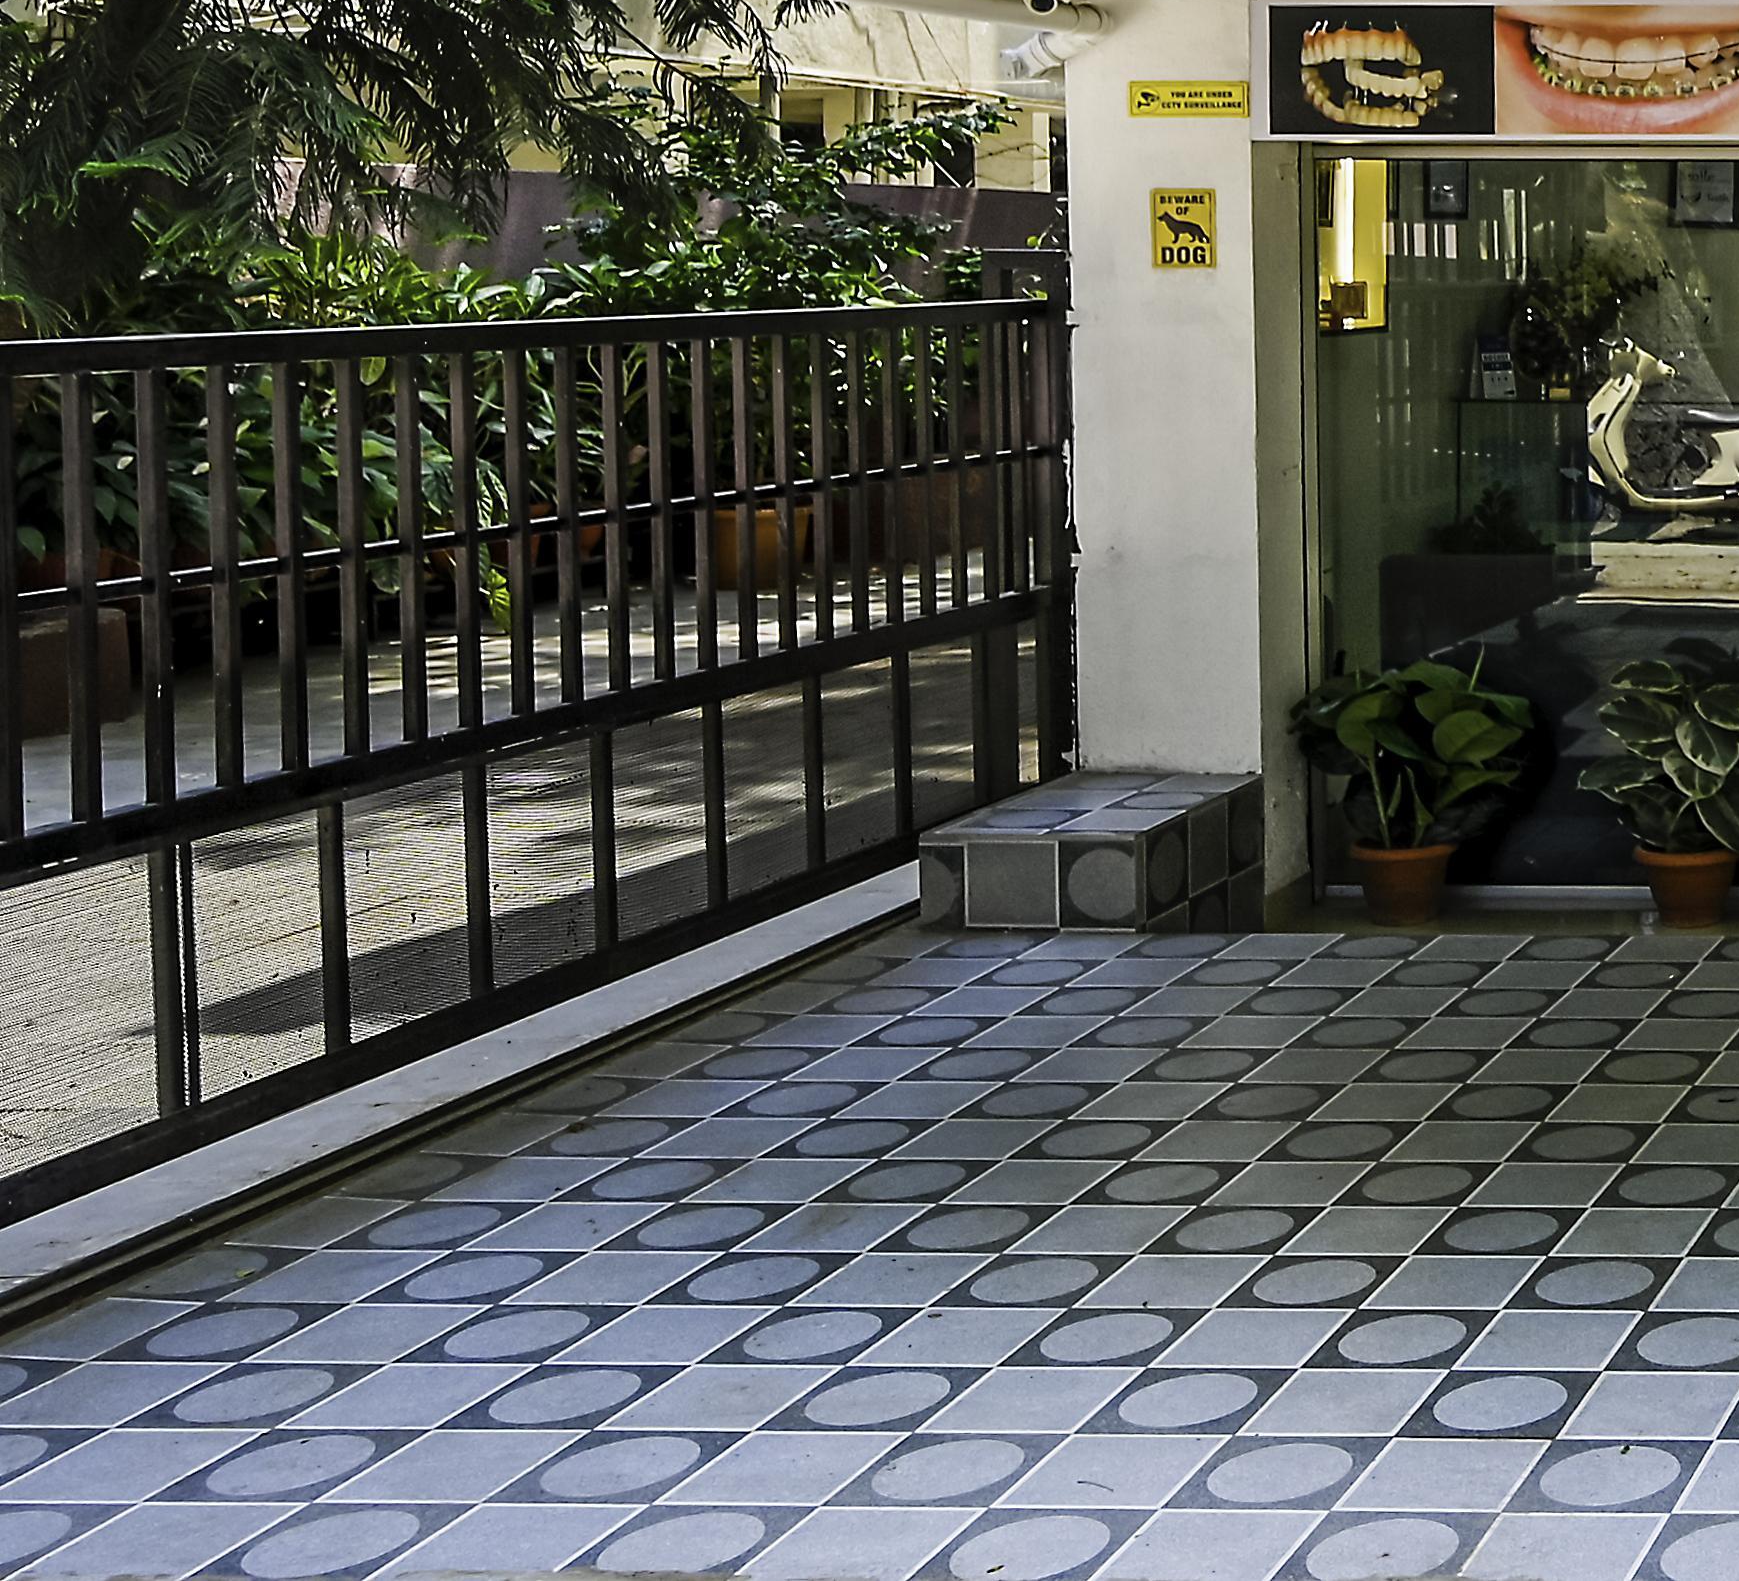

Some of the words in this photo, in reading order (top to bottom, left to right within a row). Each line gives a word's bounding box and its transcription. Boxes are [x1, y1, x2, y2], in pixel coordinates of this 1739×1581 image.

[1161, 101, 1181, 109] CCTV
[1159, 194, 1205, 205] BEWARE
[1176, 206, 1189, 216] OF
[1161, 246, 1206, 265] DOG
